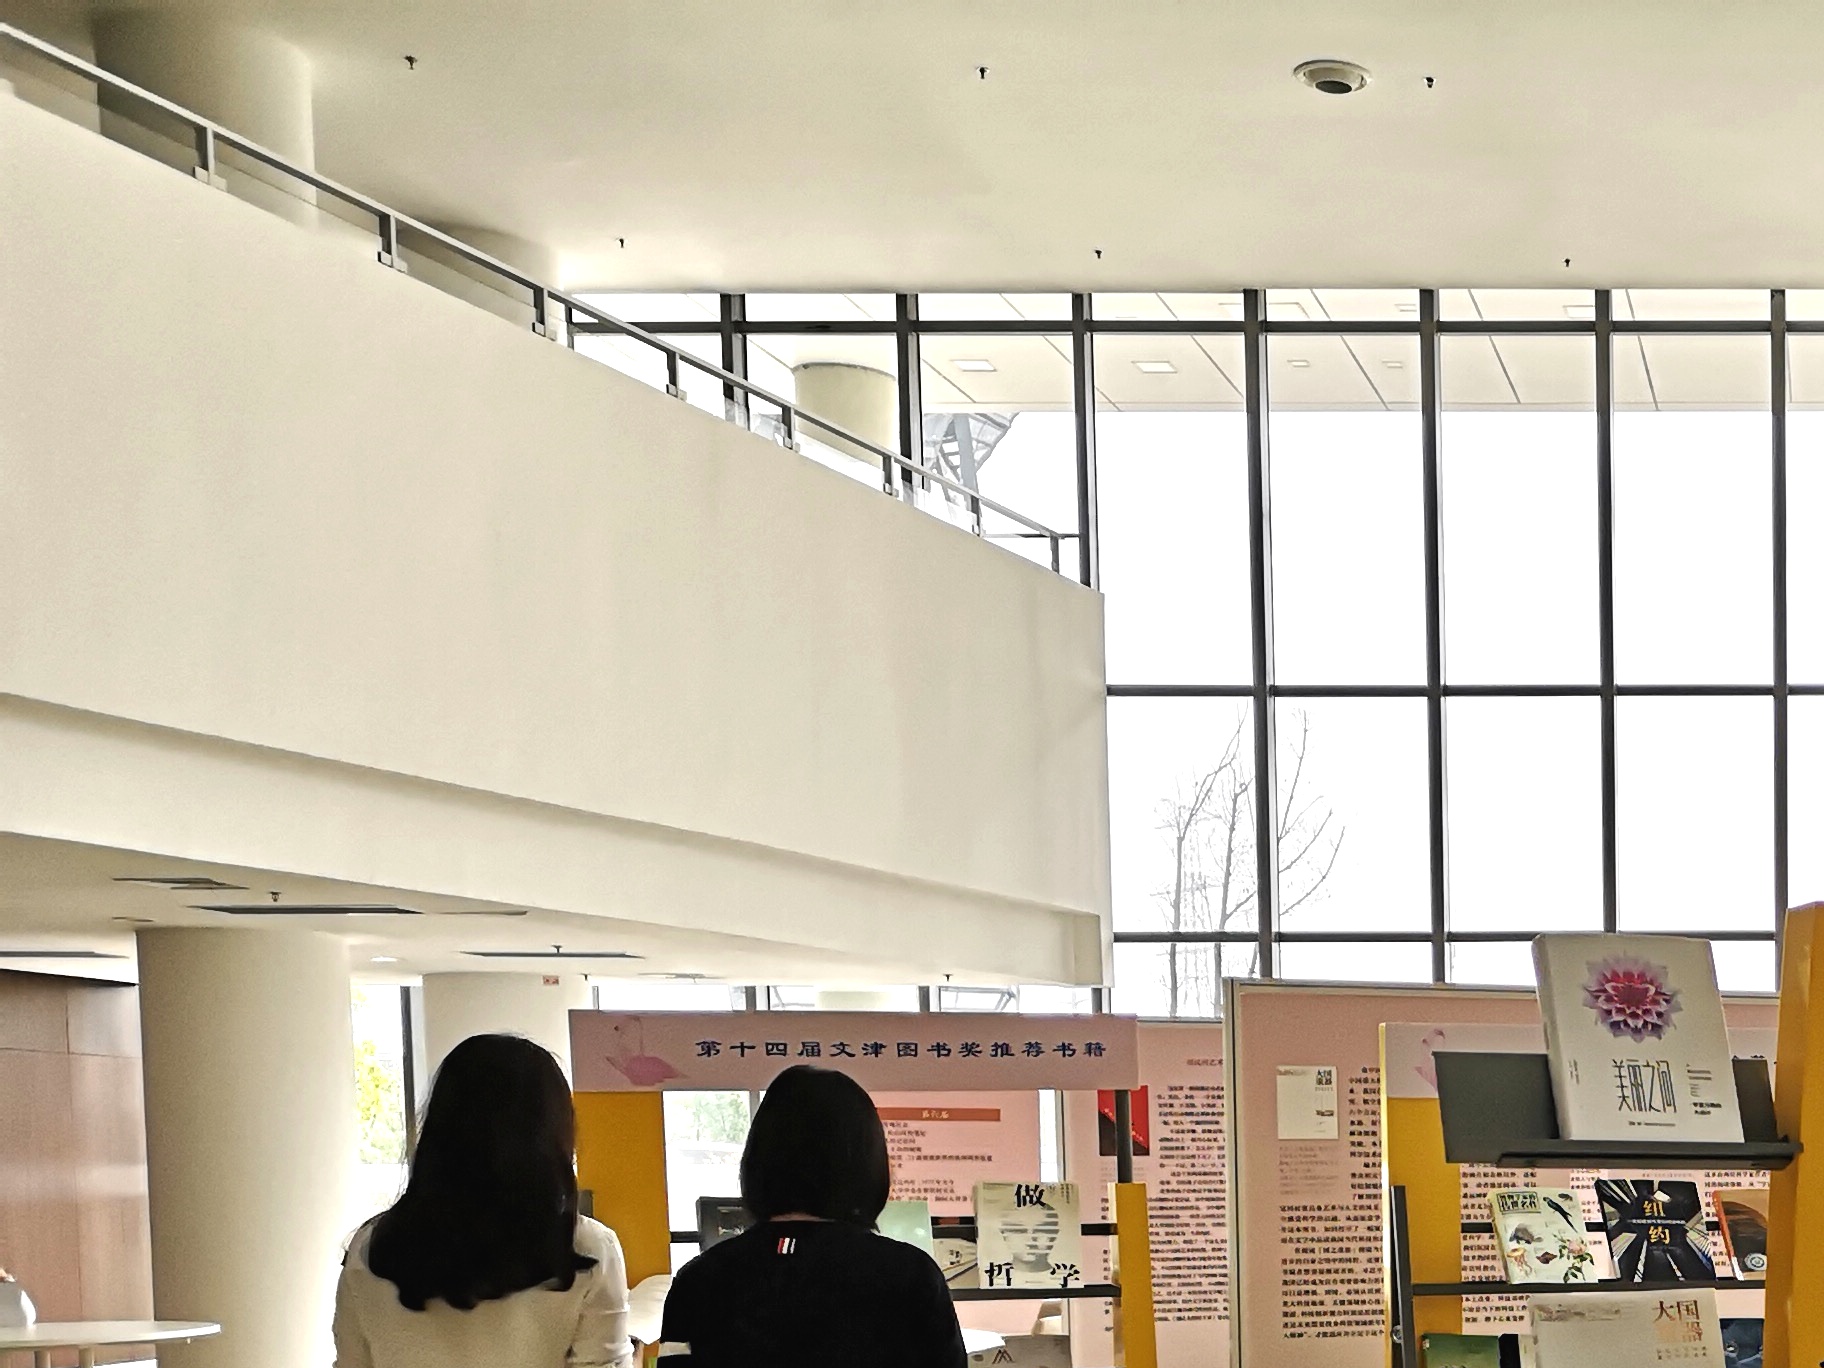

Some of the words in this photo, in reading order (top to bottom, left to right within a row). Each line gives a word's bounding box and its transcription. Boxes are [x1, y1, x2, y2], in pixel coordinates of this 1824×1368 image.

[695, 1040, 1108, 1058] 第十四届文津图书奖推荐书籍
[1612, 1058, 1677, 1113] 美丽之问
[1014, 1184, 1047, 1207] 做
[984, 1262, 1014, 1287] 哲
[1050, 1263, 1080, 1287] 学
[1652, 1299, 1700, 1323] 大国
